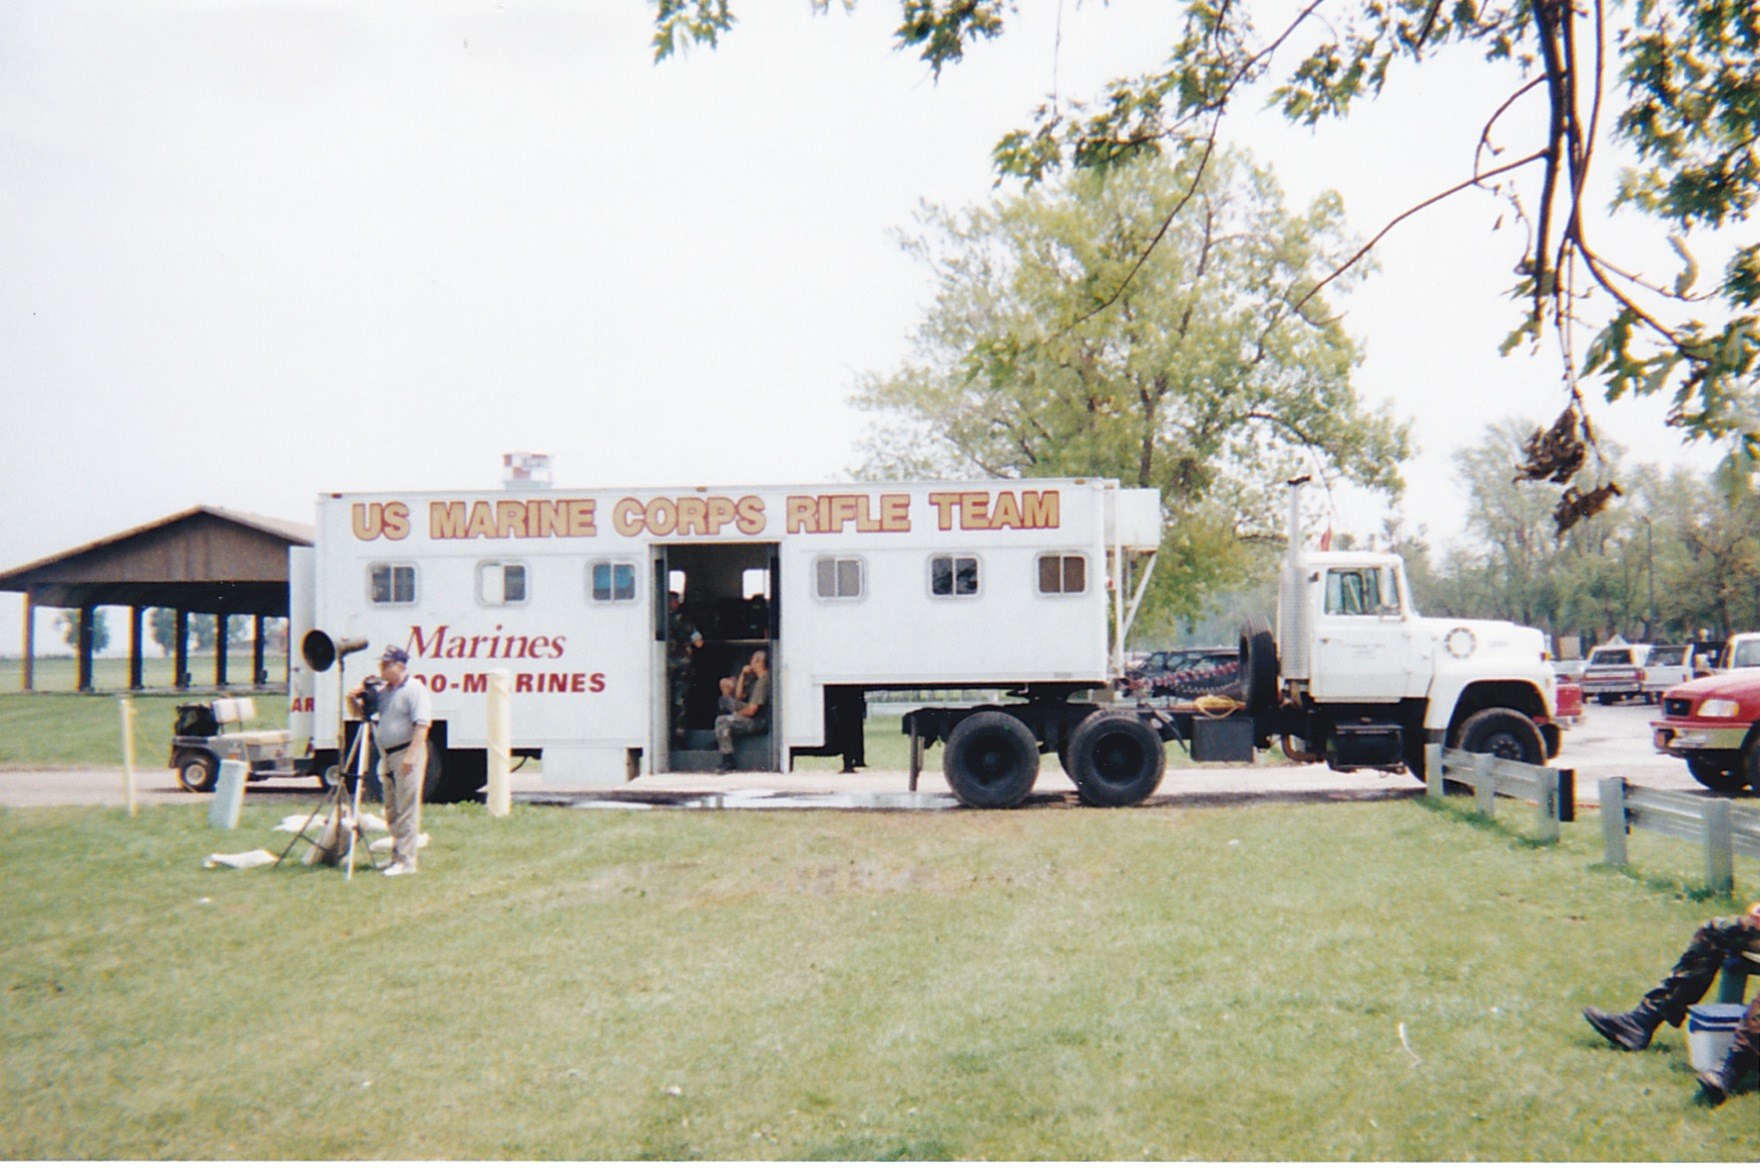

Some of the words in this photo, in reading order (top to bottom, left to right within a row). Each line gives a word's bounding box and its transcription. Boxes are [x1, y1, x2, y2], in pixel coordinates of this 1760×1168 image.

[352, 501, 410, 541] US
[429, 499, 597, 539] MARINE
[613, 496, 767, 536] CORPS
[786, 493, 911, 534] RIFLE
[928, 490, 1060, 531] TEAM
[406, 624, 566, 659] Marines
